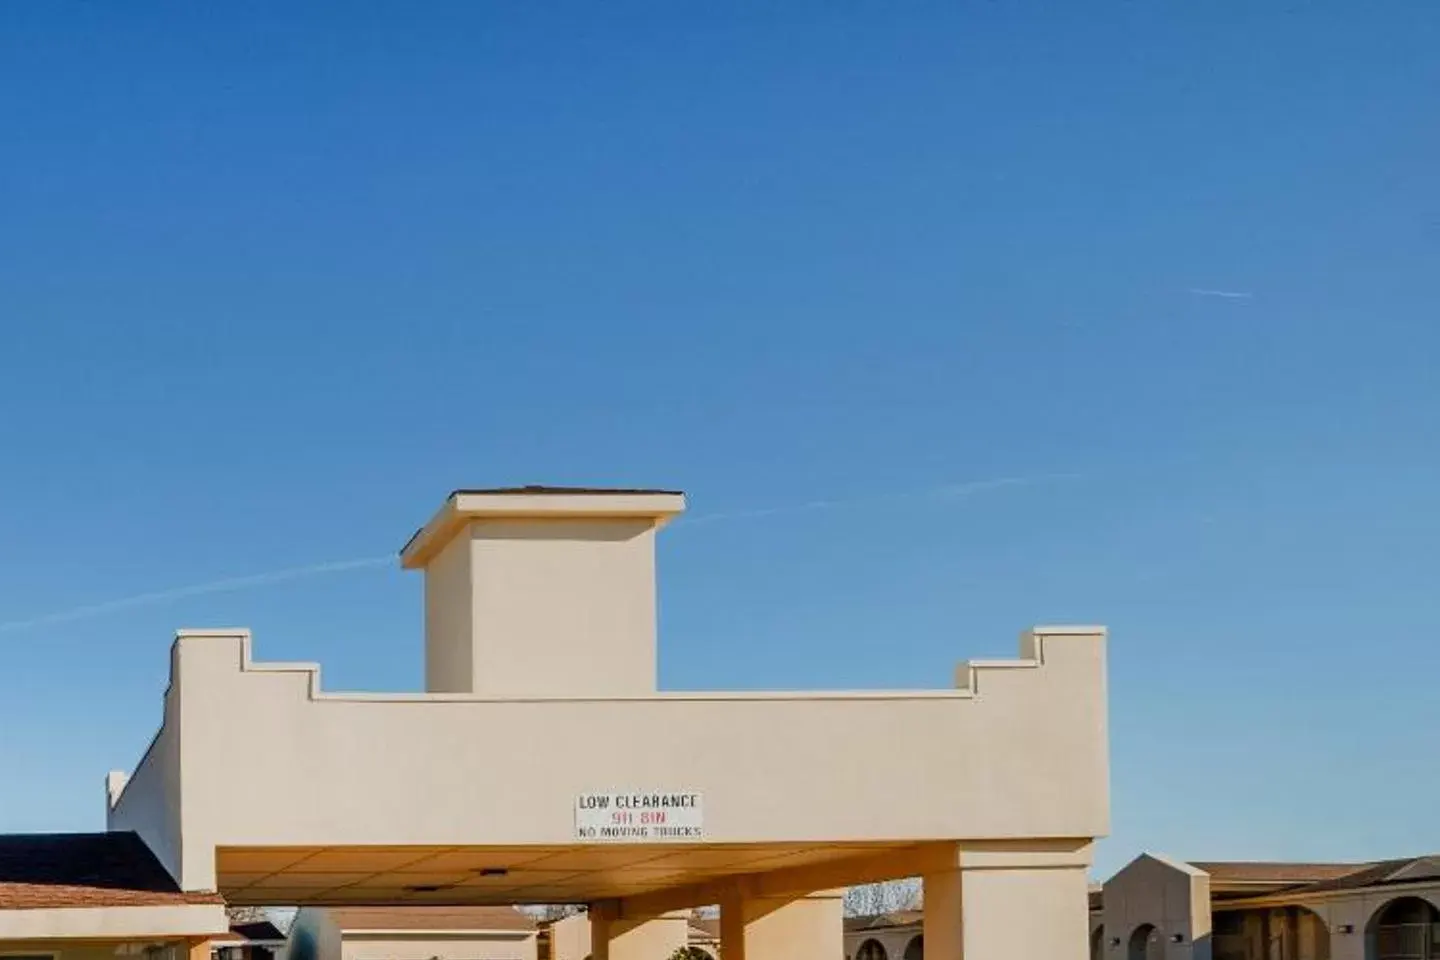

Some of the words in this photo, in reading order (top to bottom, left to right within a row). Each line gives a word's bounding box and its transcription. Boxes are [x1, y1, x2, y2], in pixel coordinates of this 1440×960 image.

[579, 795, 609, 809] LOW
[616, 794, 697, 809] CLEARANCE
[579, 827, 596, 837] NO
[601, 827, 648, 837] MOVING
[653, 827, 701, 837] TRUCKS
